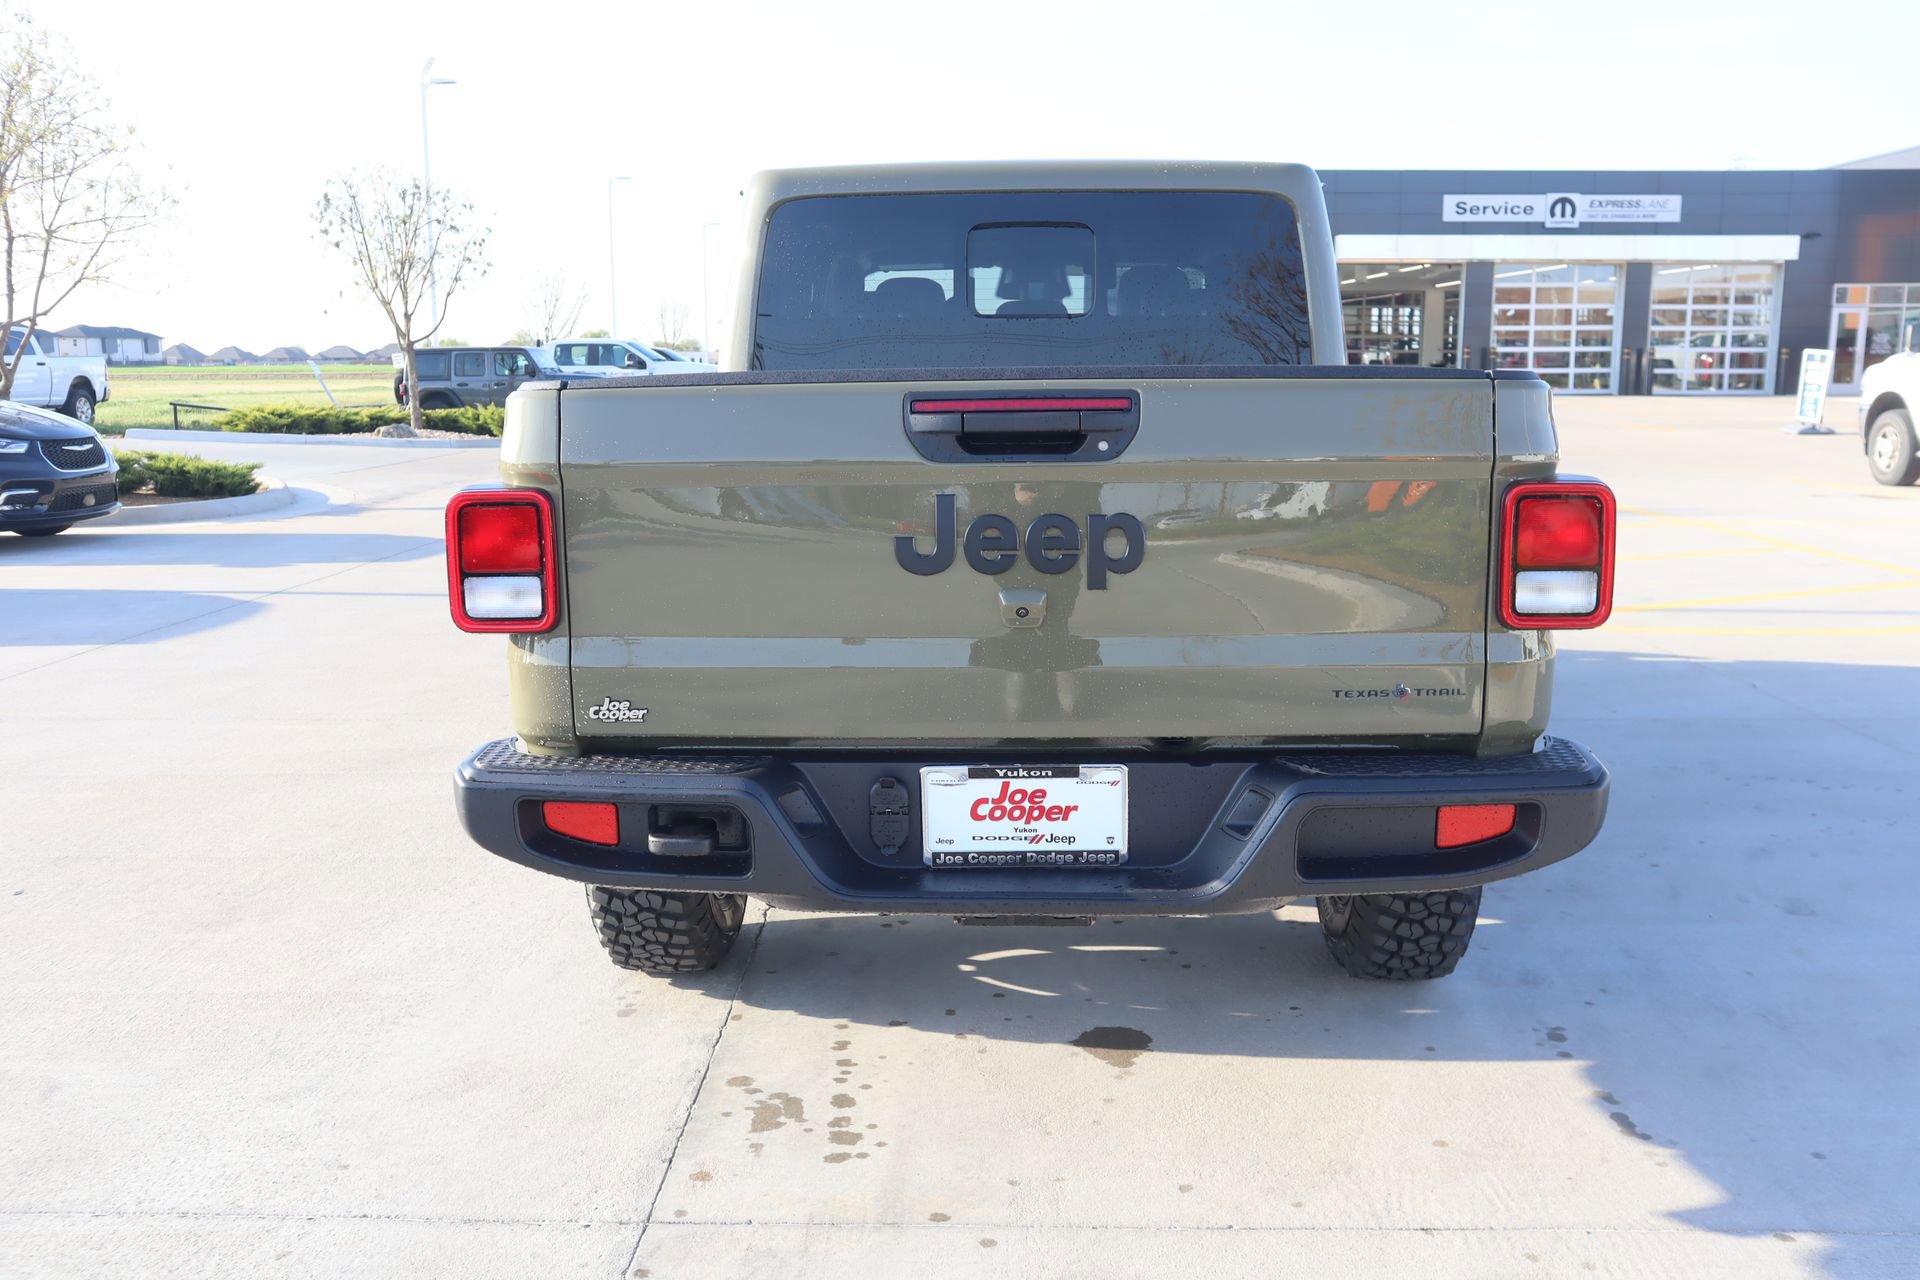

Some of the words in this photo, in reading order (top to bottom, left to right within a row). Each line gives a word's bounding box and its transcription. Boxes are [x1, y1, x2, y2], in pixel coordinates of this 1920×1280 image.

[1455, 201, 1535, 216] Service
[895, 494, 1146, 590] Jeep
[1332, 689, 1390, 698] TEXAS
[1414, 688, 1466, 696] TRAIL
[600, 697, 631, 711] Joe
[588, 706, 648, 720] Cooper
[995, 769, 1053, 777] Yukon
[991, 781, 1048, 805] Joe
[969, 798, 1079, 825] Cooper
[935, 837, 955, 845] Jeep
[1045, 833, 1076, 845] Jeep
[935, 853, 963, 864] Joe
[968, 852, 1022, 865] Cooper
[1027, 852, 1074, 865] Dodge
[1078, 851, 1116, 864] Jeep
